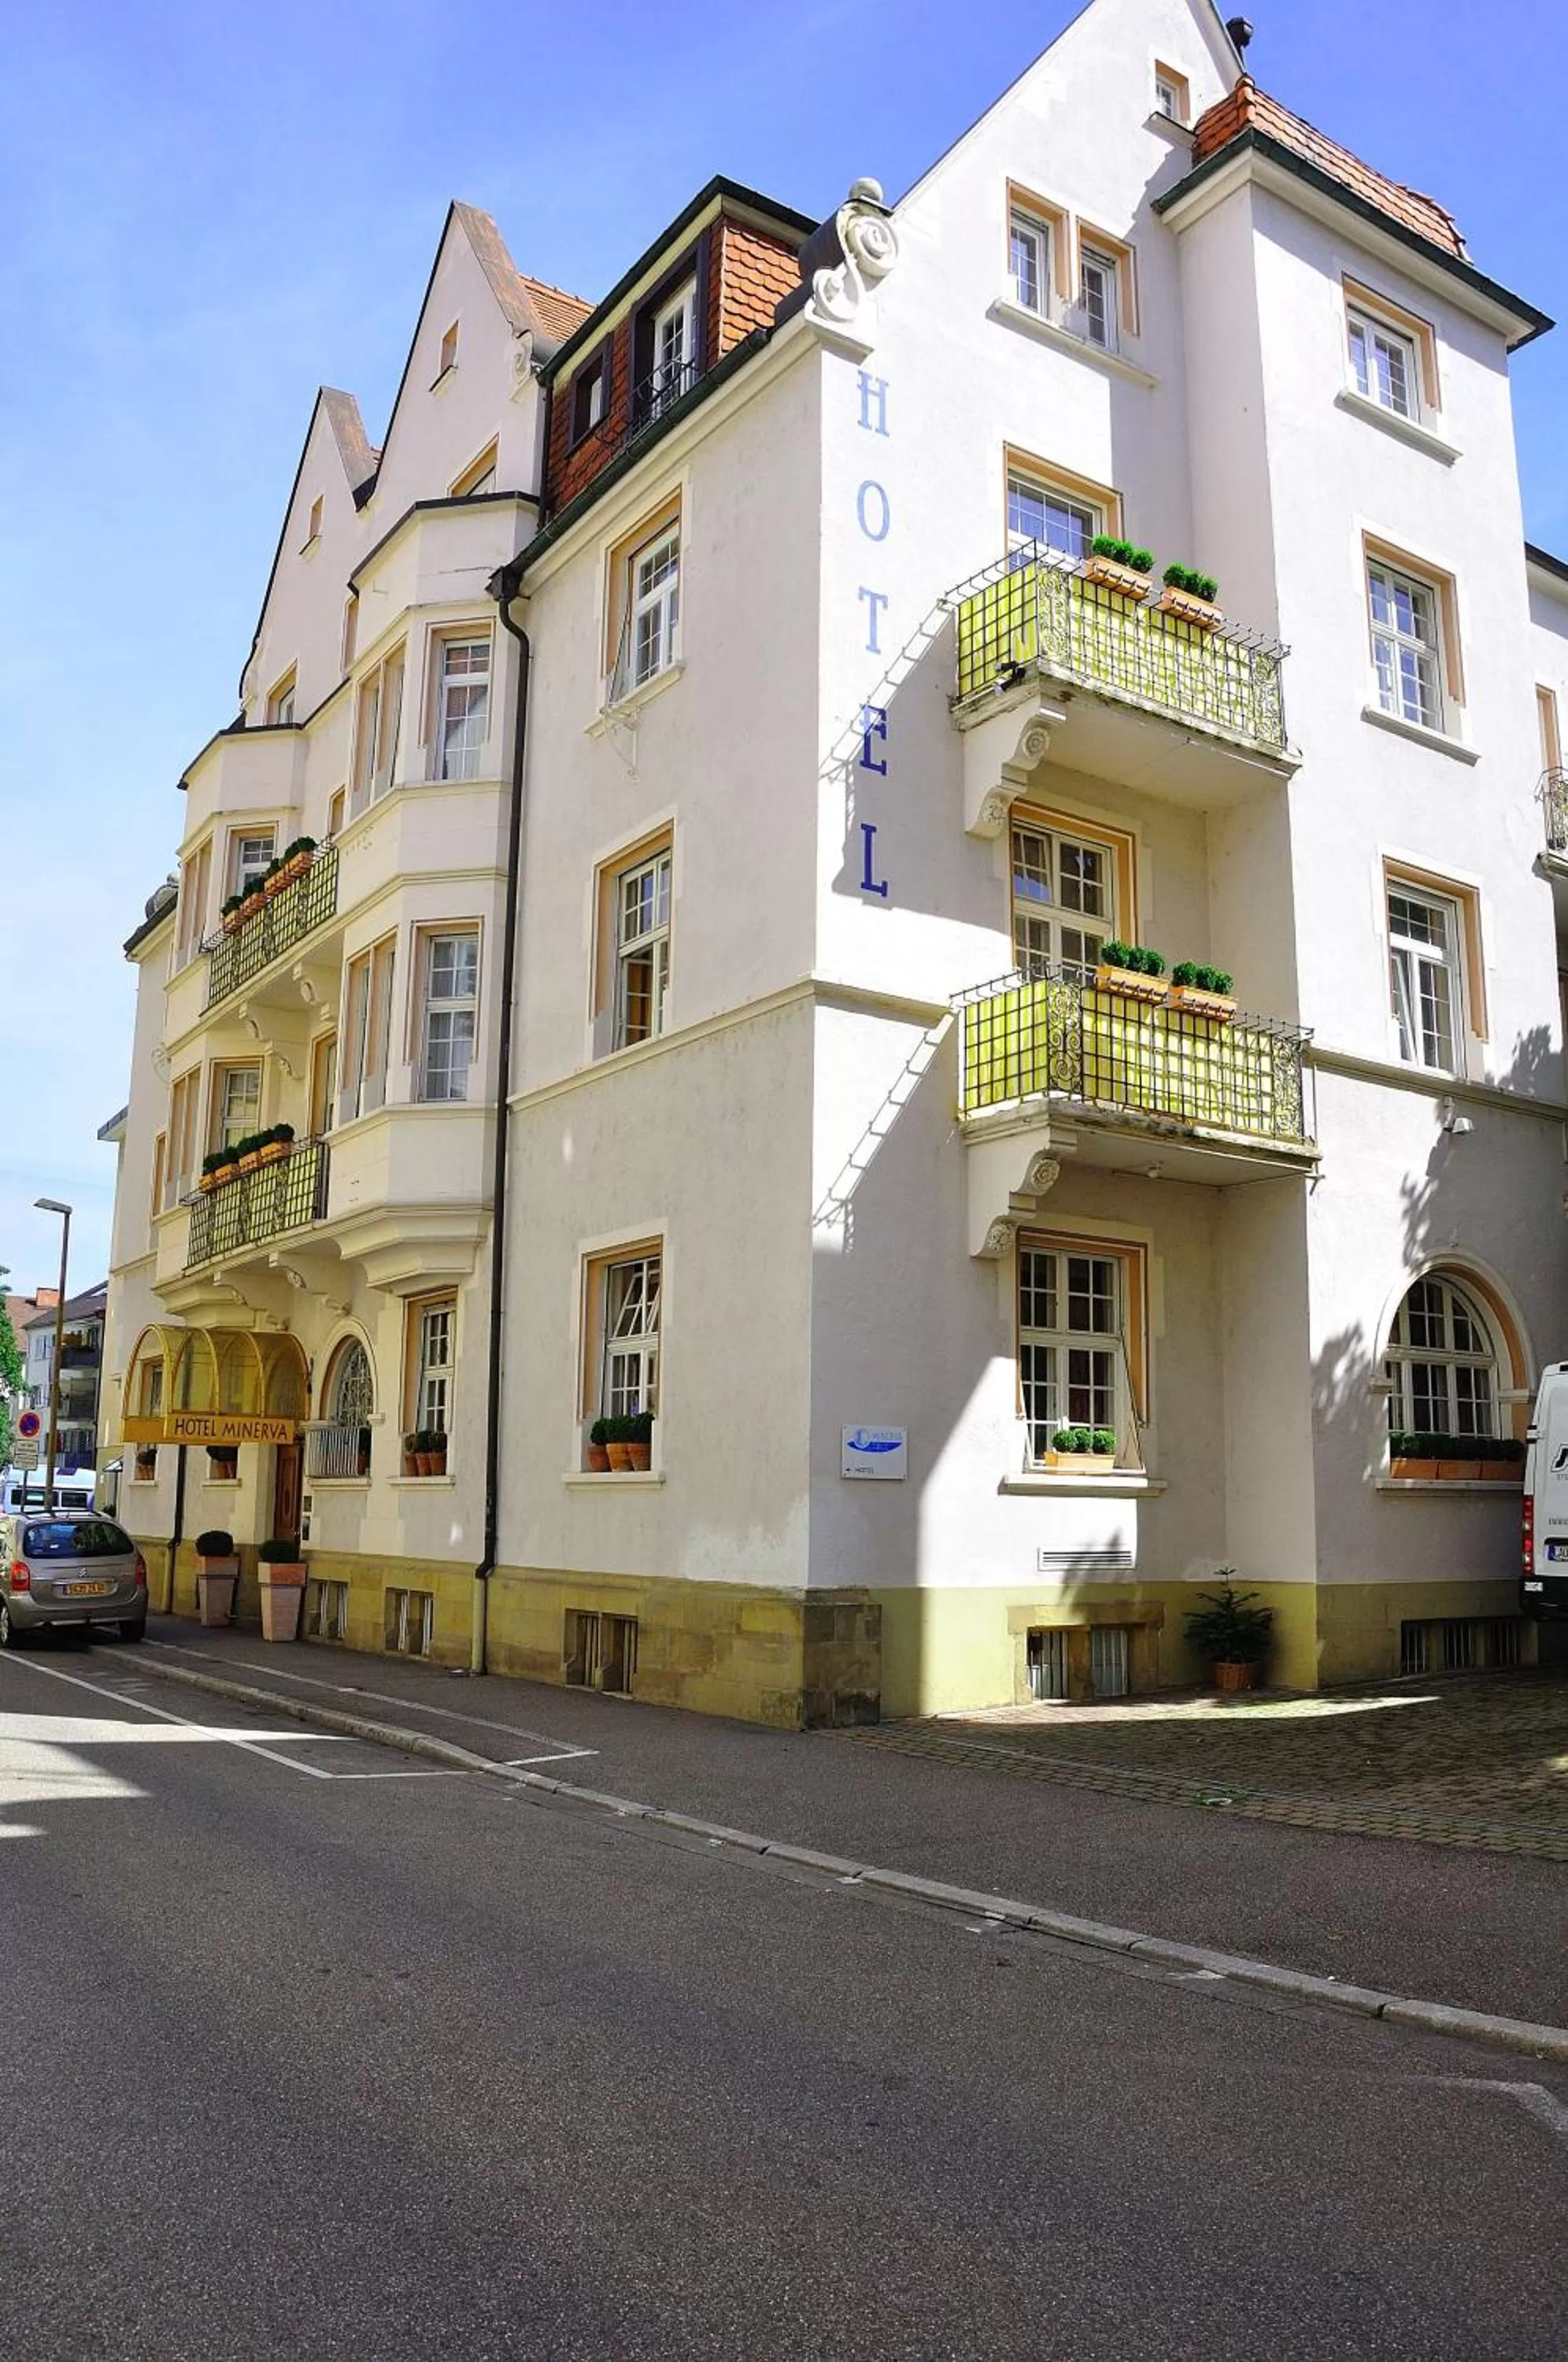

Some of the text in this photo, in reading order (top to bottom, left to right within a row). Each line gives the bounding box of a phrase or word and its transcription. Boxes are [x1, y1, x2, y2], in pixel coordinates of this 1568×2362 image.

[856, 369, 890, 897] HOTEL
[174, 1417, 288, 1440] HOTEL MINERVA
